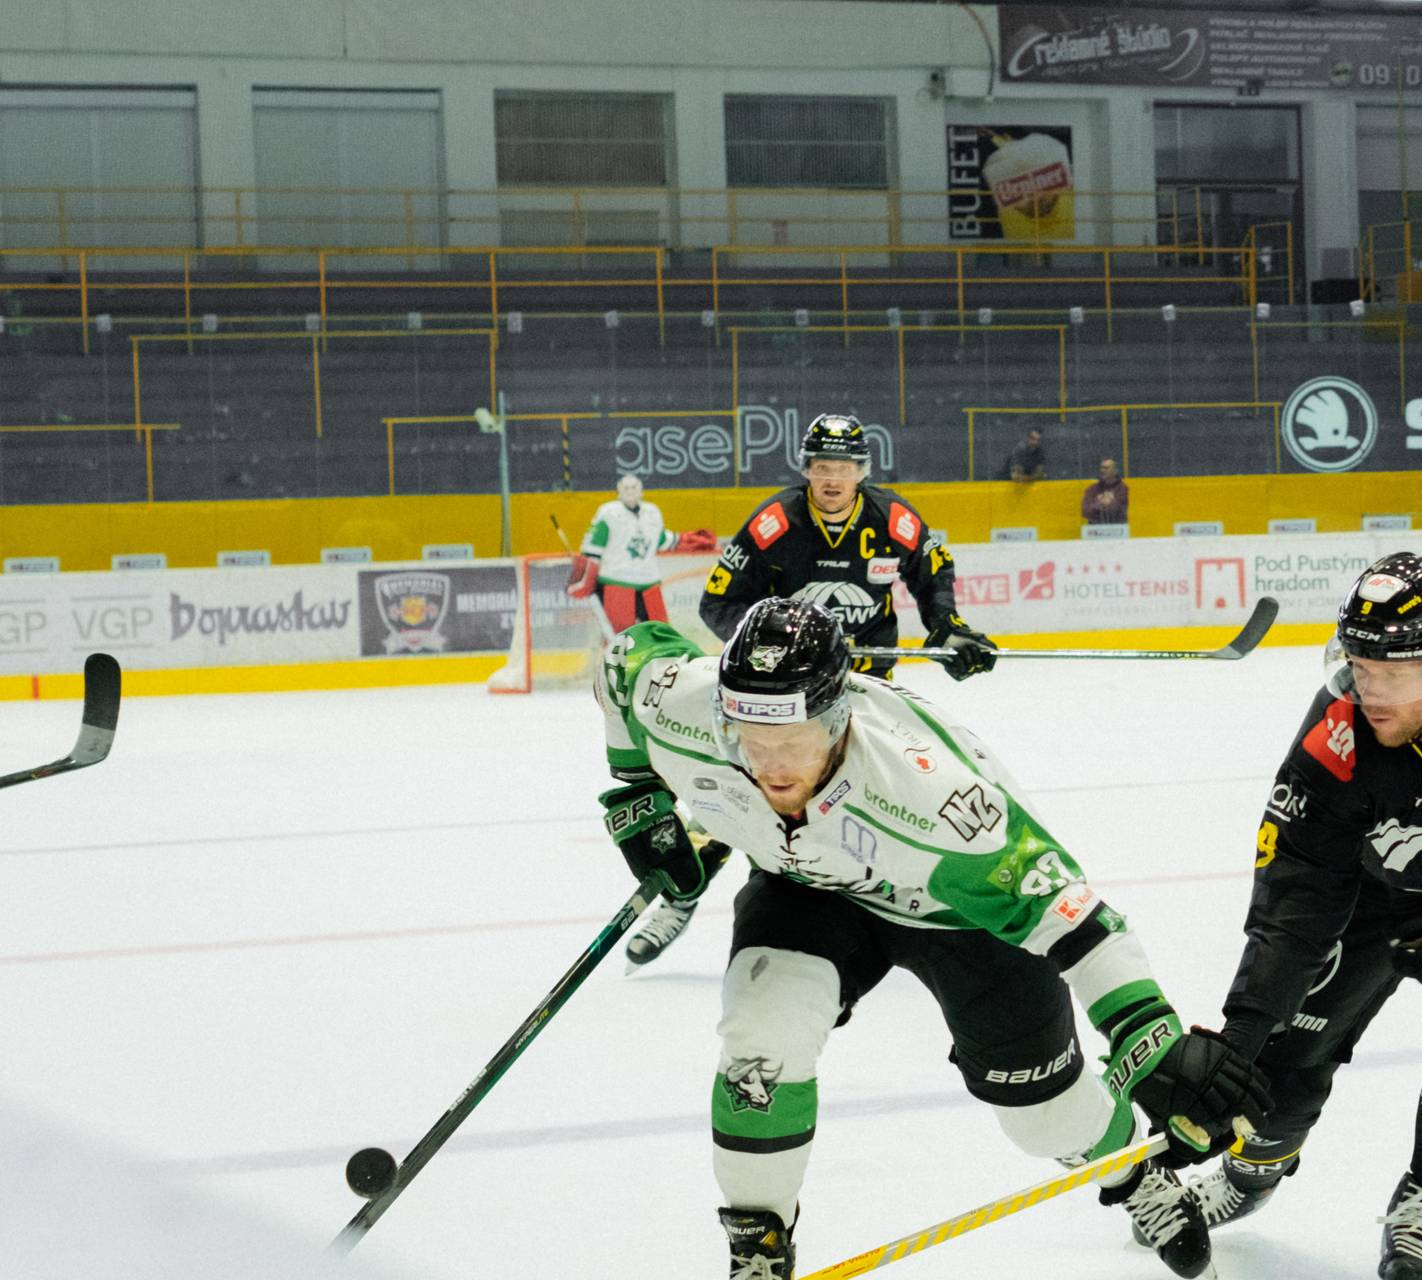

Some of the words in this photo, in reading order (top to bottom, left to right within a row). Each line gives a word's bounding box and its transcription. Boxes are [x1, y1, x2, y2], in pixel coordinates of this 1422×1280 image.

[949, 126, 981, 236] BUFET
[860, 528, 876, 559] C
[1255, 556, 1291, 573] Pod
[1297, 554, 1369, 575] Pustým
[1255, 574, 1329, 592] hradom
[71, 607, 153, 641] VGP
[1346, 627, 1381, 641] CCM
[740, 703, 794, 716] TIPOS
[864, 783, 938, 835] brantner
[939, 784, 1003, 842] NZ
